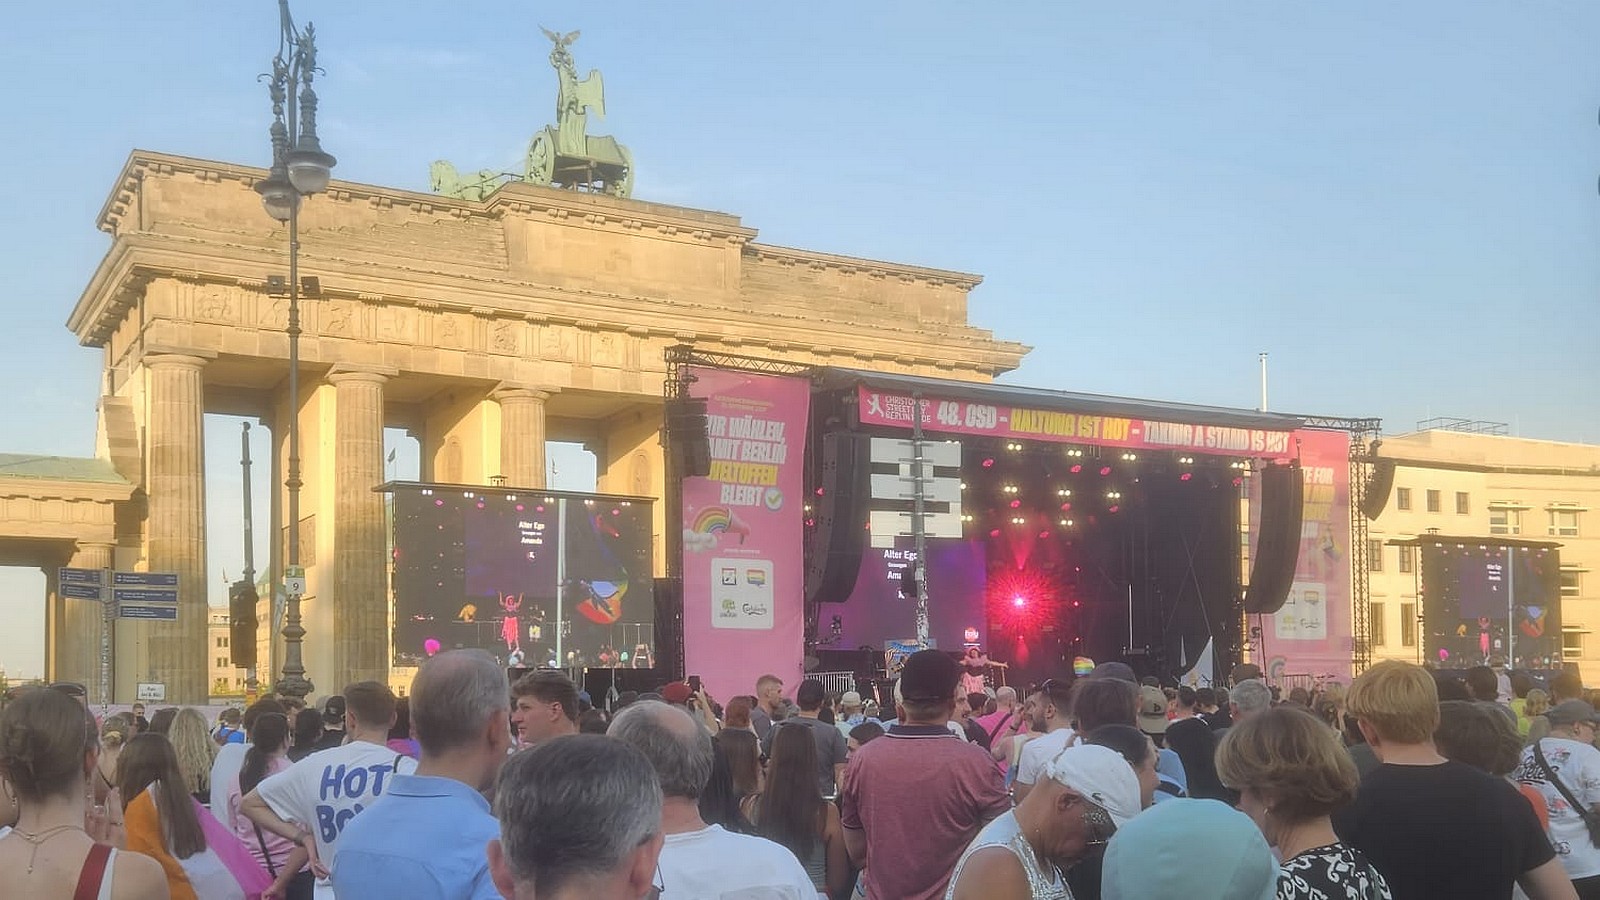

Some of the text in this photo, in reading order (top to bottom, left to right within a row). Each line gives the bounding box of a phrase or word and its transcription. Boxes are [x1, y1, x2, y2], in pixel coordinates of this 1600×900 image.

[885, 395, 930, 406] CHRISTOER
[886, 411, 910, 421] BERLIN
[937, 401, 962, 426] 48.
[965, 404, 997, 429] CSD
[1010, 408, 1076, 436] HALTUNG
[1078, 414, 1101, 438] IST
[1103, 417, 1131, 441] HOT
[1143, 420, 1192, 445] TAKING
[1194, 425, 1204, 447] A
[1206, 426, 1249, 450] STAND
[1251, 430, 1264, 451] IS
[1266, 431, 1290, 453] HOT
[708, 437, 787, 464] MIT BERLIN
[1301, 466, 1334, 484] TE FOR
[720, 484, 764, 507] BLEIBT
[884, 550, 902, 559] Alter
[293, 583, 299, 591] 9
[320, 763, 394, 801] HOT
[315, 804, 364, 843] BO
